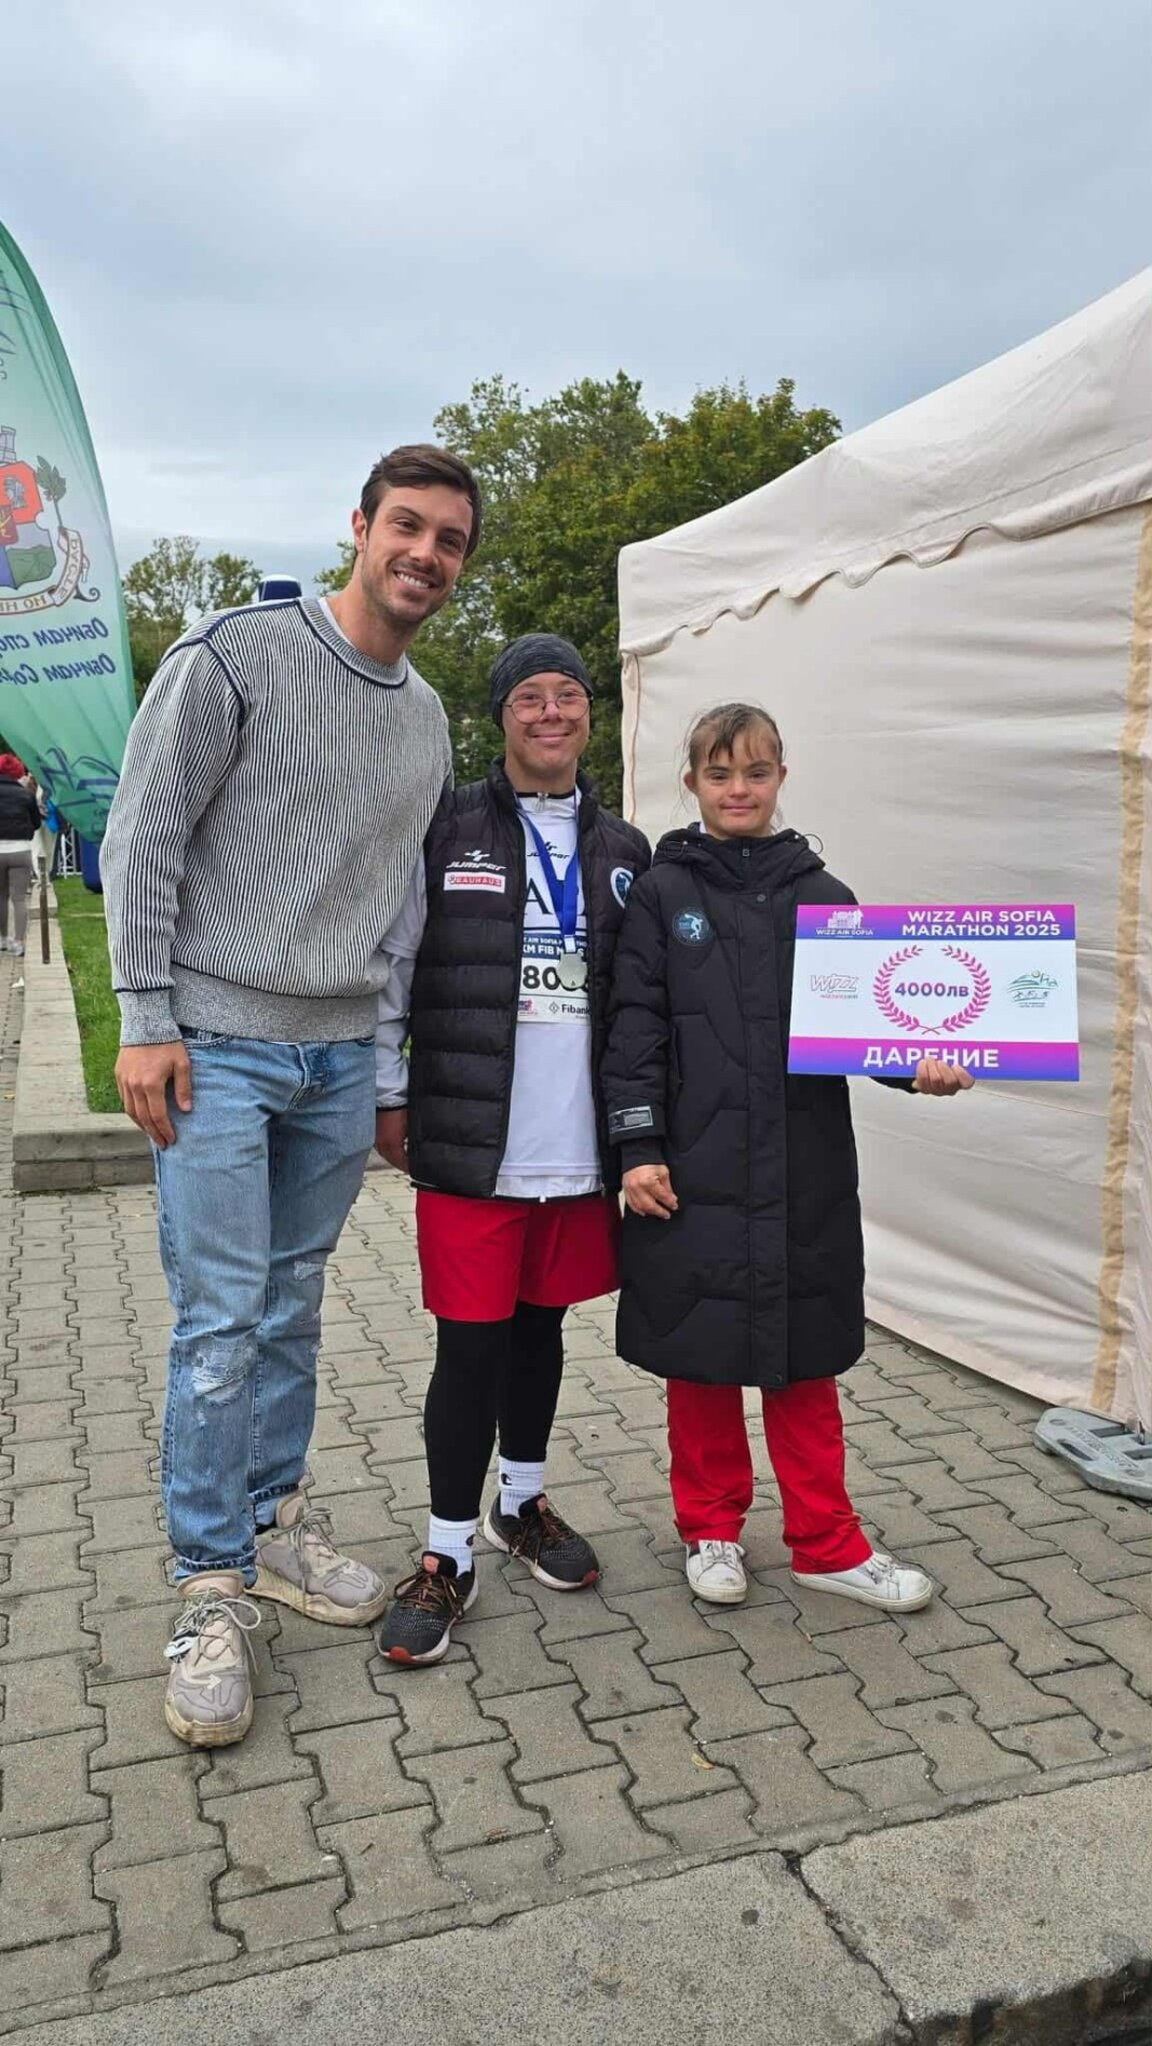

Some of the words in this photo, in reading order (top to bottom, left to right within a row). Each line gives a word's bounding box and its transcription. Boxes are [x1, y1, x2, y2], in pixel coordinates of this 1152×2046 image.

[455, 876, 503, 887] BAUHAUS
[907, 911, 956, 922] WIZZ
[961, 911, 993, 922] AIR
[999, 910, 1056, 922] SOFIA
[902, 924, 1009, 936] MARATHON
[1014, 924, 1061, 936] 2025
[863, 1046, 1000, 1068] ДАРЕНИЕ
